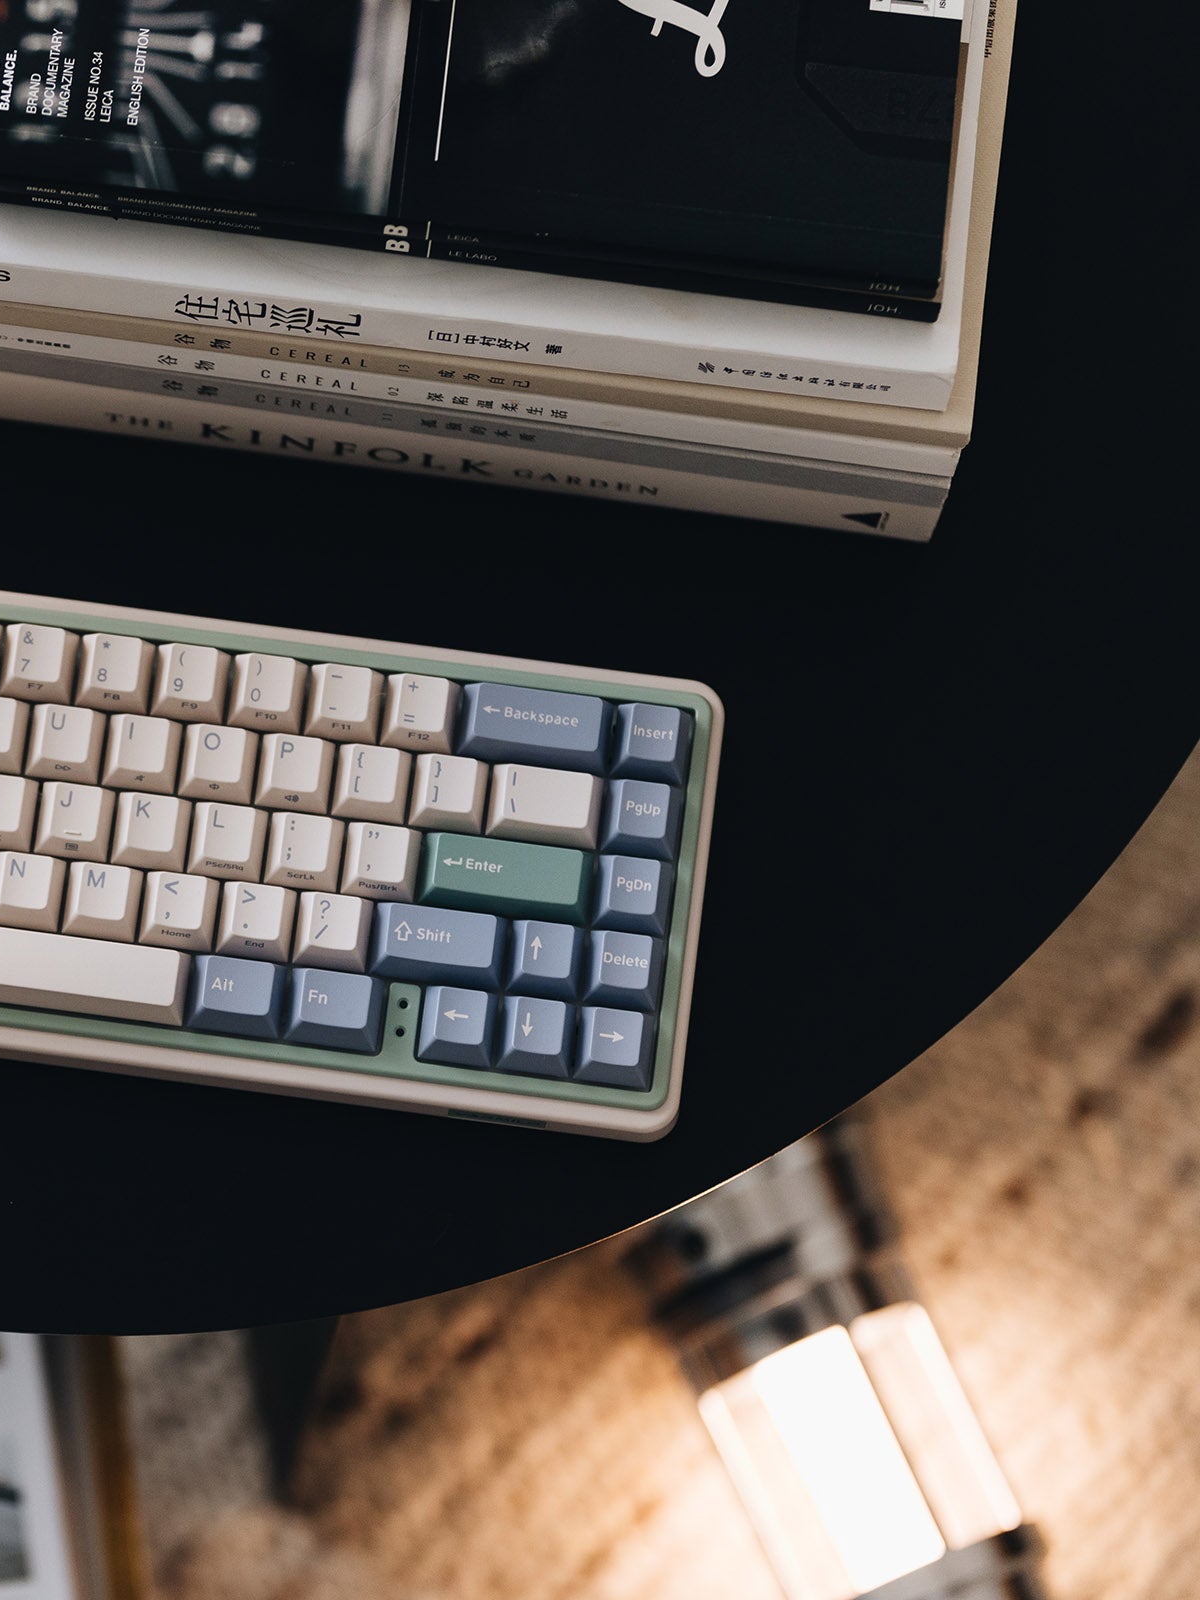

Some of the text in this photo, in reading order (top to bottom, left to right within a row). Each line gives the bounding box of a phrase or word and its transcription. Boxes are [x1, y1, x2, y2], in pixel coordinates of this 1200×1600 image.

[0, 49, 18, 111] BALANCE.
[41, 28, 65, 116] DOCUMENTARY
[127, 28, 150, 126] ENGLISH EDITION
[26, 73, 42, 114] BRAND
[57, 58, 75, 118] MAGAZINE
[84, 51, 103, 121] ISSUE NO.34
[99, 90, 114, 123] LEICA
[31, 197, 64, 206] BRAND.
[67, 202, 112, 212] BALANCE.
[447, 234, 480, 243] LEICA
[448, 250, 498, 262] LE LABO
[174, 294, 362, 339] 住宅巡礼
[270, 346, 368, 369] CEREAL
[261, 369, 359, 392] CEREAL
[438, 369, 531, 389] 成为自己
[255, 394, 353, 417] CEREAL
[104, 411, 659, 496] THE KINFOLK GARDEN
[21, 659, 31, 672] 7
[97, 668, 107, 682] 8
[28, 682, 43, 690] F7
[174, 679, 184, 692] 9
[104, 692, 120, 701] F8
[250, 688, 261, 702] 0
[181, 702, 198, 710] F9
[51, 712, 66, 730] U
[255, 712, 277, 721] F10
[504, 706, 579, 728] Backspace
[332, 721, 351, 731] F11
[633, 725, 674, 741] Insert
[204, 732, 221, 750] O
[408, 732, 429, 741] F12
[280, 742, 294, 759] P
[60, 790, 73, 808] J
[136, 800, 150, 818] K
[626, 801, 661, 817] PgUp
[213, 810, 225, 828] L
[10, 859, 27, 878] N
[465, 858, 503, 874] Enter
[87, 870, 106, 888] M
[287, 872, 315, 881] ScrLk
[616, 877, 652, 893] PgDn
[161, 929, 191, 939] Home
[416, 927, 452, 944] Shift
[245, 940, 265, 949] End
[603, 952, 649, 969] Delete
[211, 977, 234, 993] Alt
[308, 989, 327, 1005] Fn
